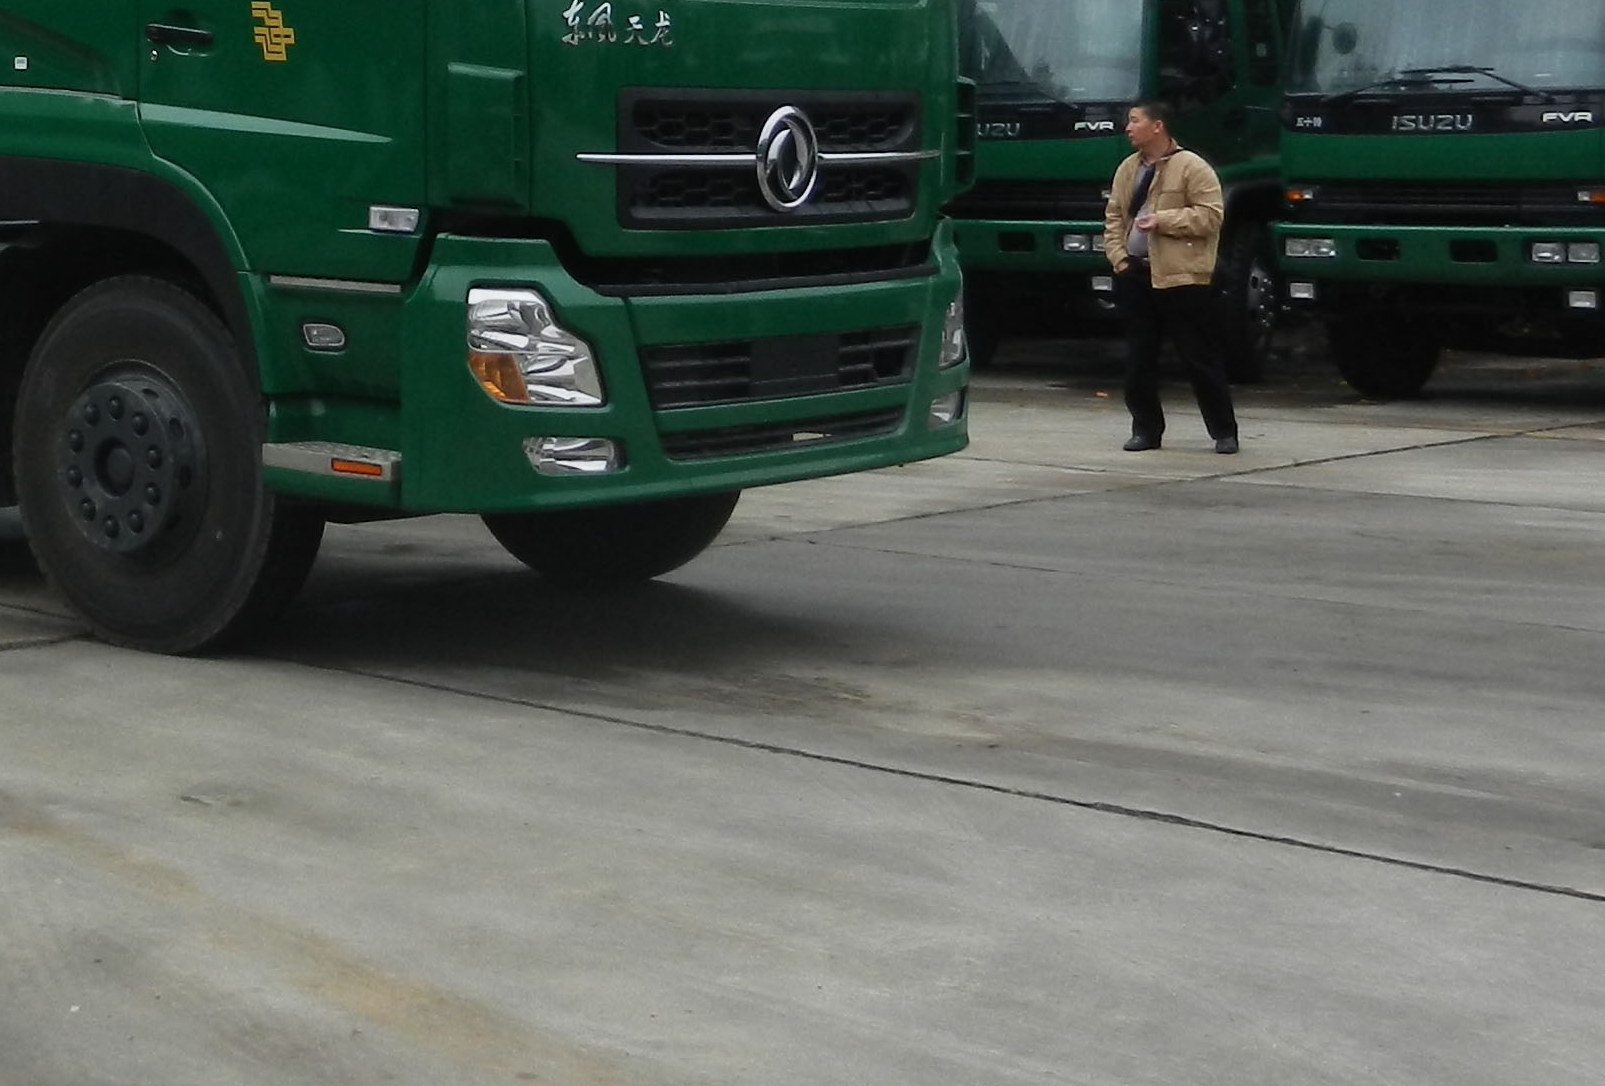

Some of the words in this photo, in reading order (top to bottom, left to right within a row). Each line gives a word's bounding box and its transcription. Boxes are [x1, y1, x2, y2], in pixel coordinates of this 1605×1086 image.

[1391, 114, 1474, 131] ISUZU
[1542, 111, 1592, 123] FVR
[976, 121, 1021, 137] UZU
[1074, 120, 1116, 131] FVR
